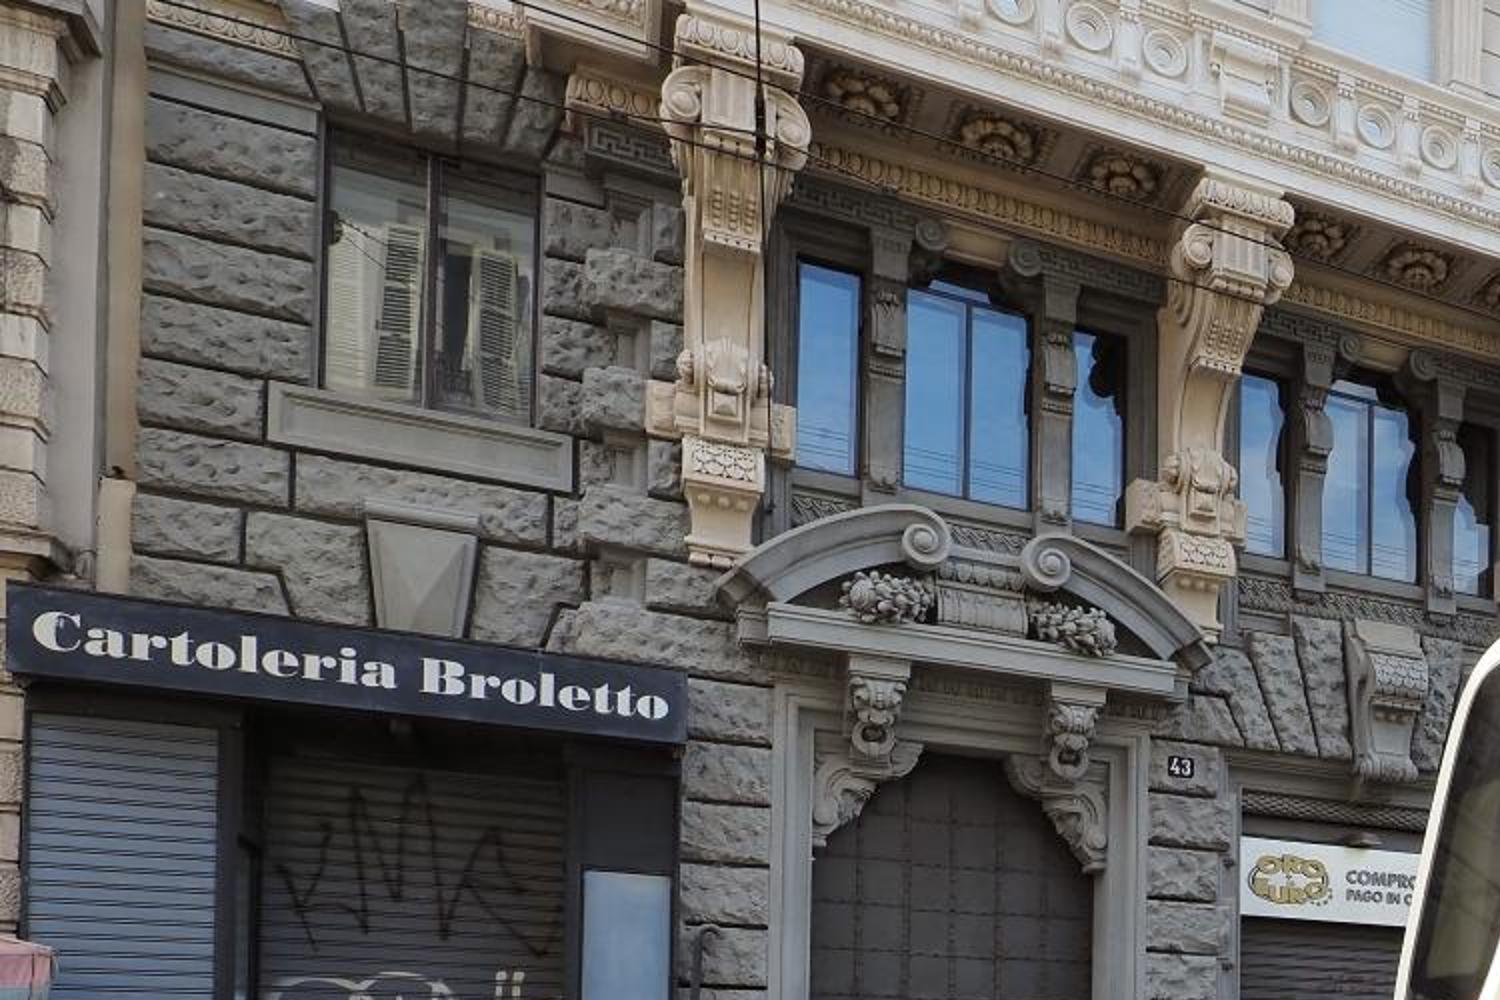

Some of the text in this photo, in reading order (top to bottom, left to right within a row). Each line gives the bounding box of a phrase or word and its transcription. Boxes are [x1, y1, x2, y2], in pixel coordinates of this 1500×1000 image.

[32, 611, 670, 721] Cartoleria Broletto
[1170, 757, 1191, 777] 43
[1254, 853, 1327, 878] ORO
[1345, 889, 1383, 904] PAGO
